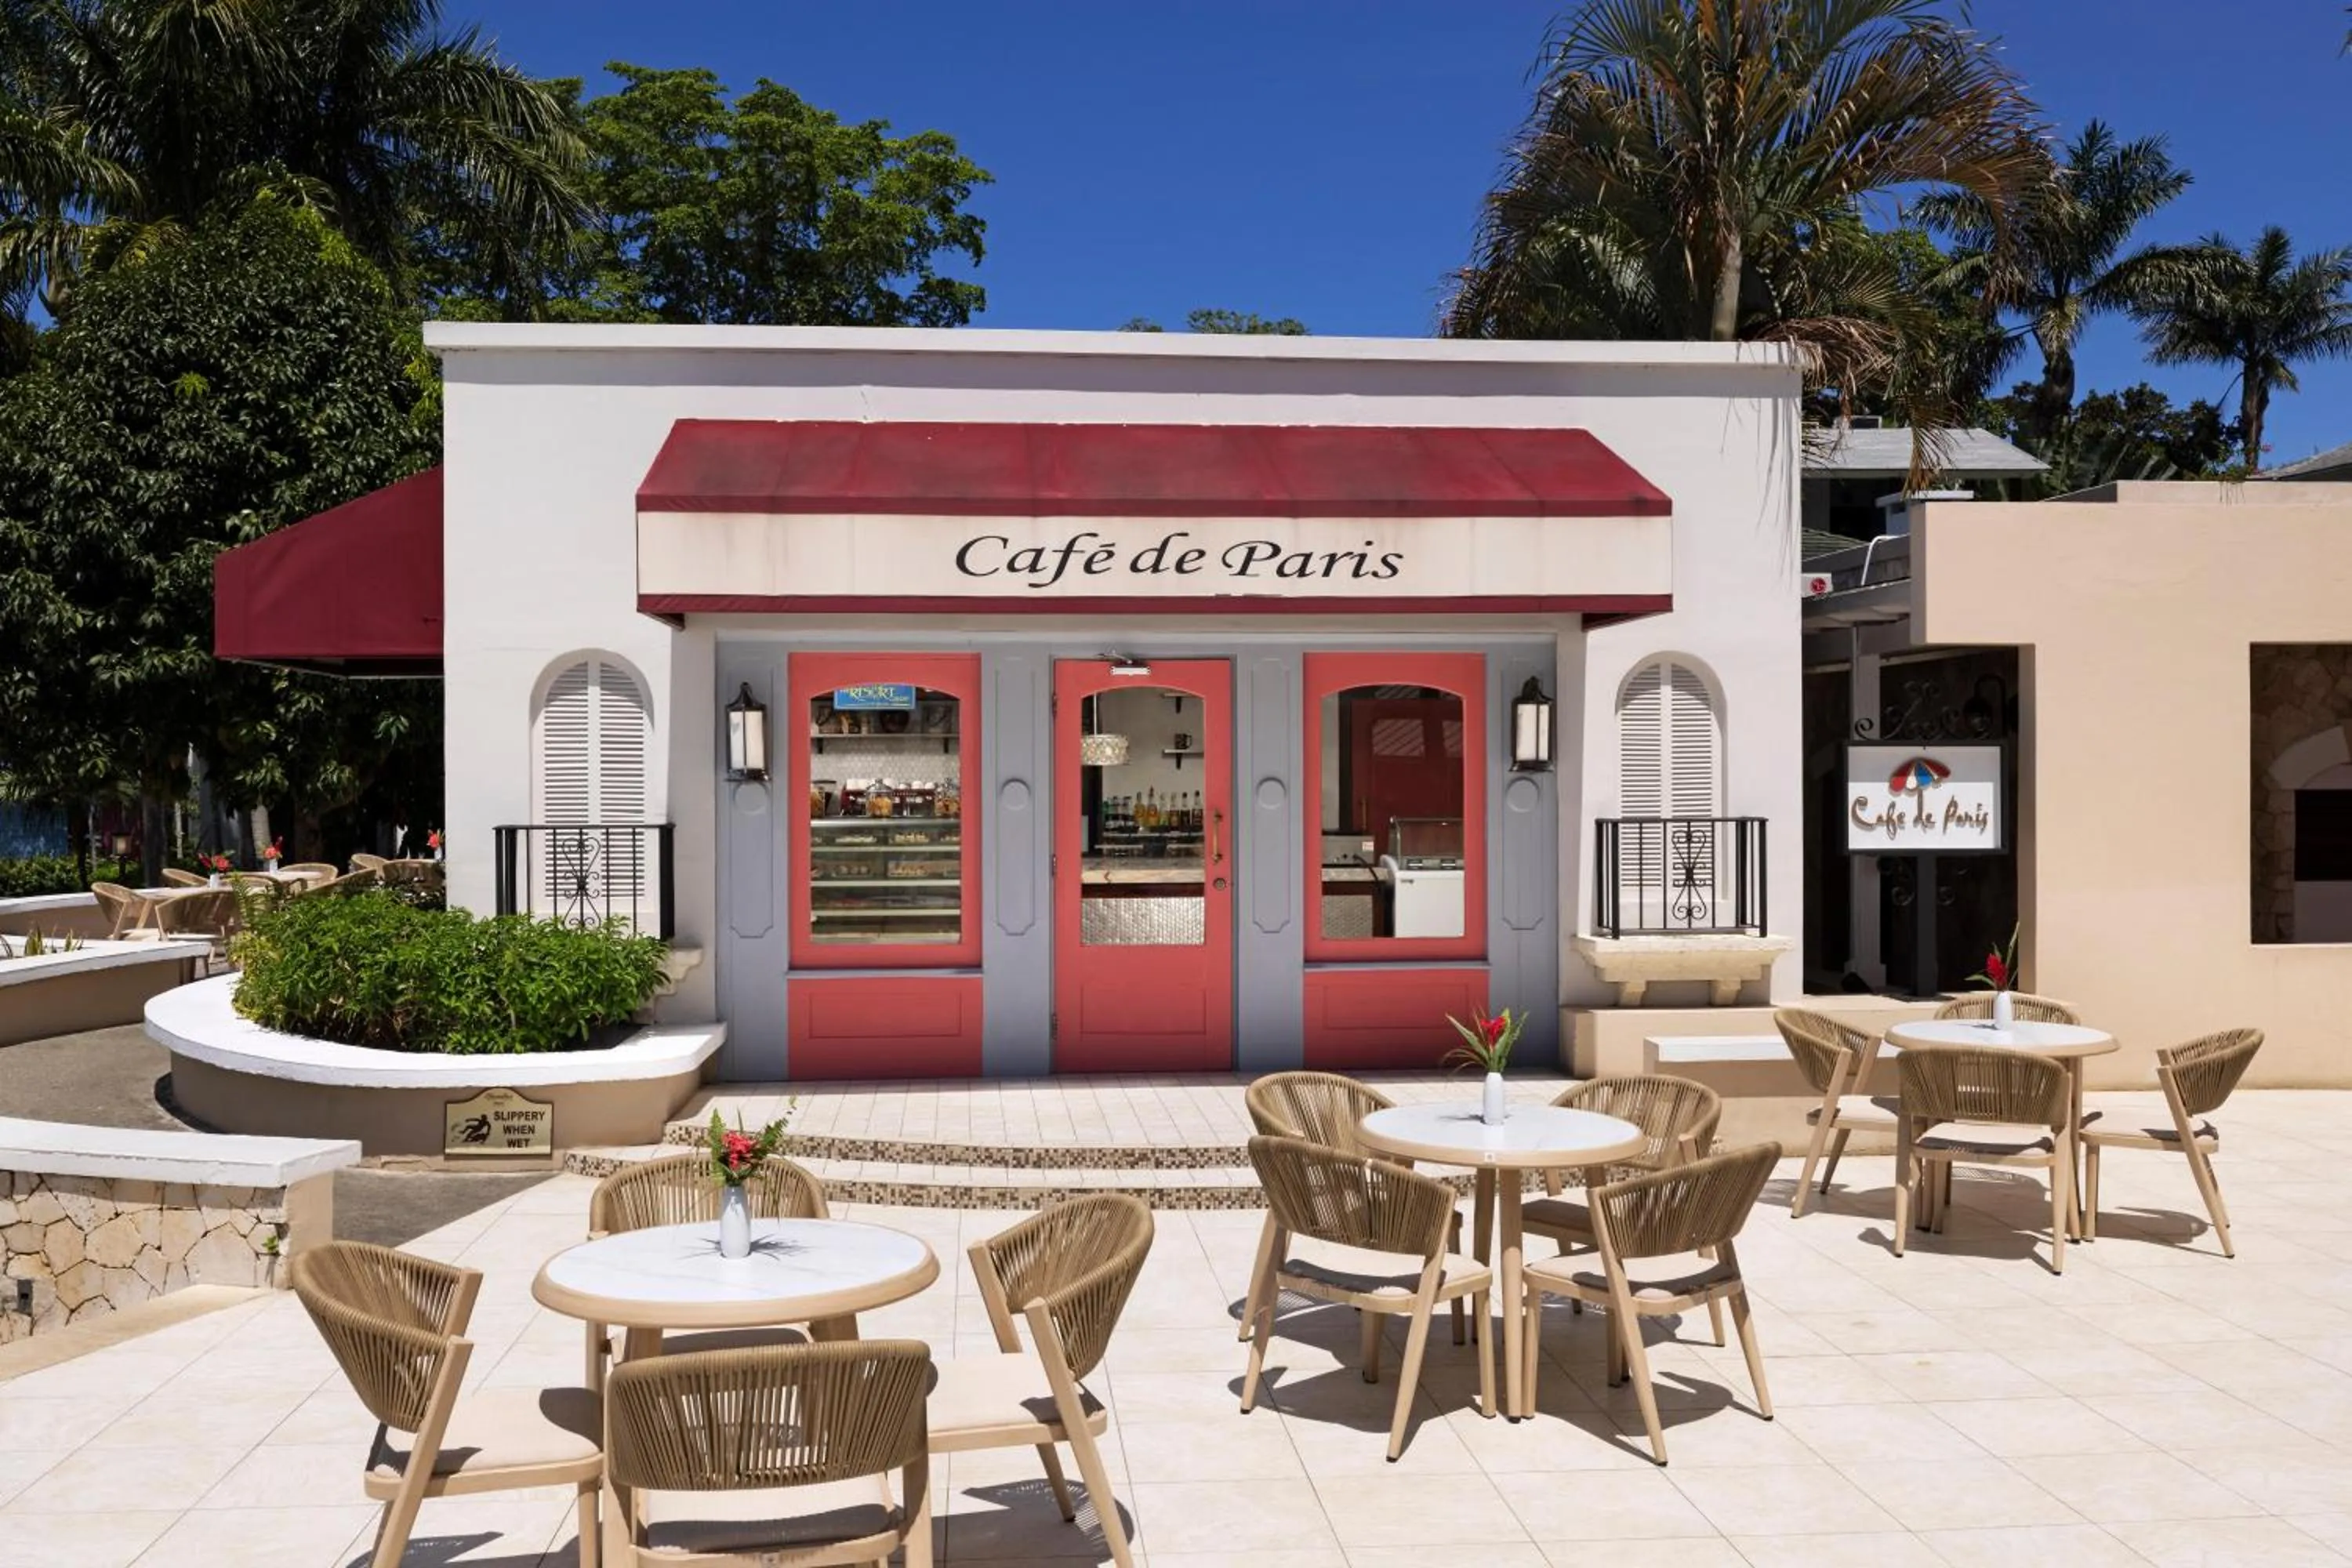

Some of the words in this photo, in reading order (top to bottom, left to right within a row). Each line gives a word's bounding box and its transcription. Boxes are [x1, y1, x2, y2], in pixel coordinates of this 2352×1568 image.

[955, 532, 1116, 589] Café
[1129, 532, 1207, 575] de
[1221, 539, 1405, 579] Paris
[1913, 790, 1936, 833] de
[1942, 795, 1989, 835] Paris
[493, 1111, 546, 1121] SLIPPERY
[503, 1124, 535, 1135] WHEN
[506, 1138, 531, 1148] WET
